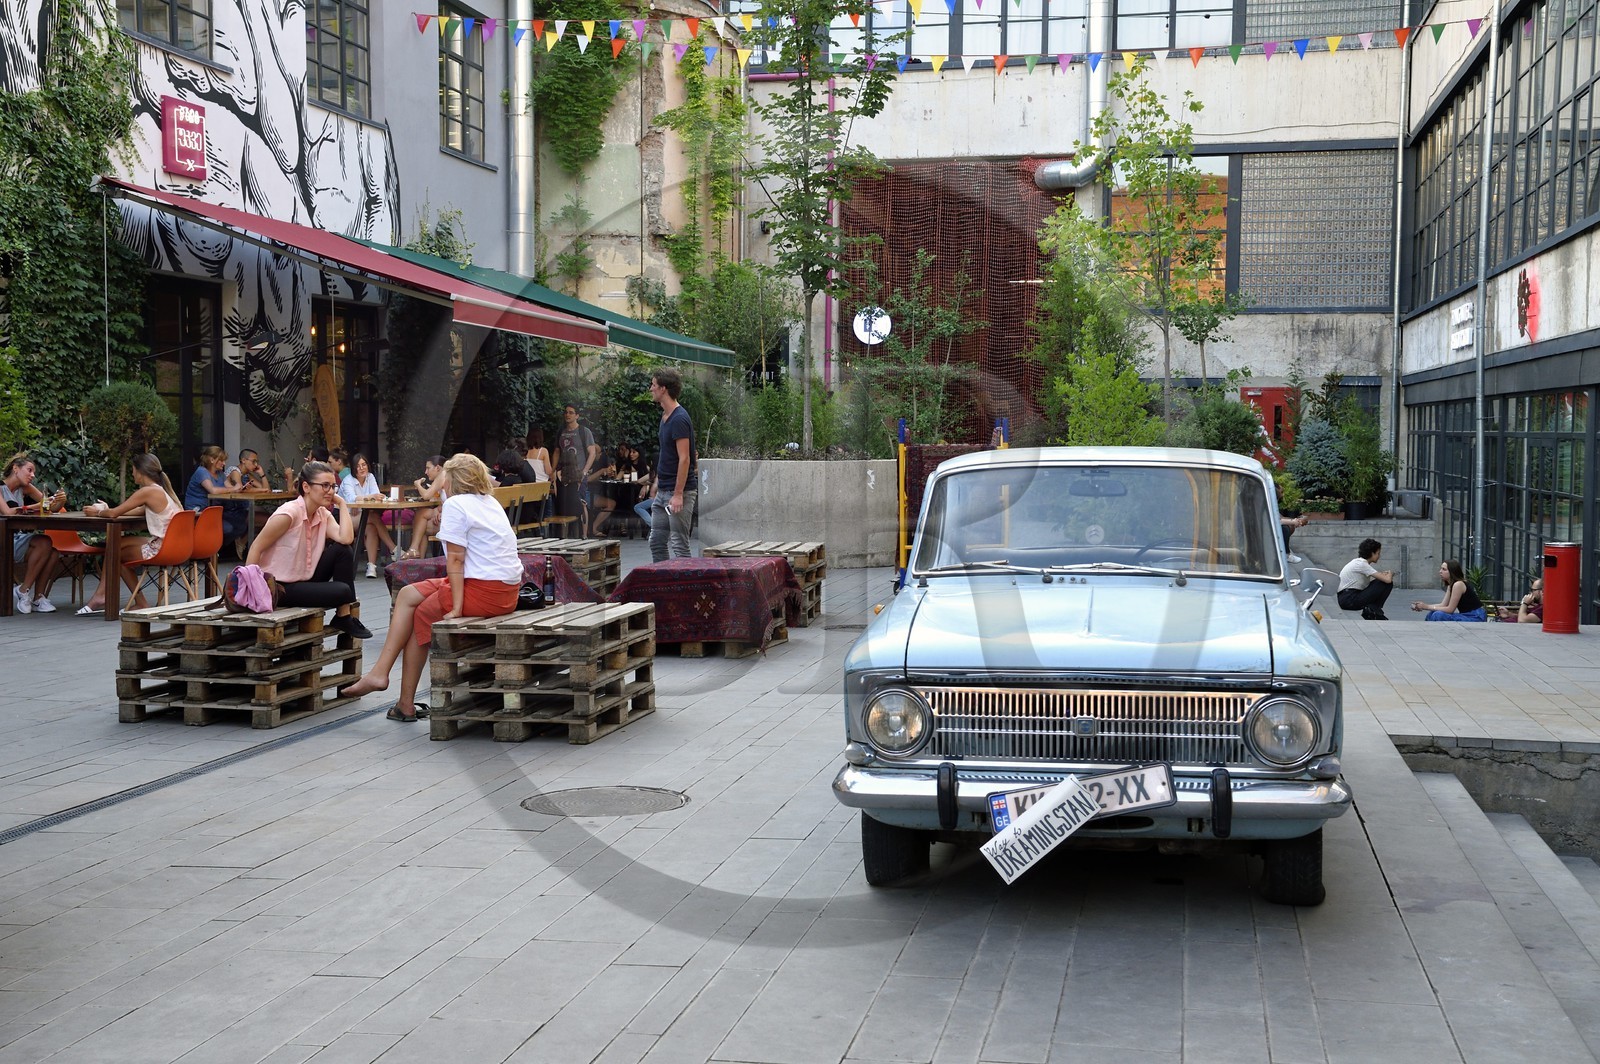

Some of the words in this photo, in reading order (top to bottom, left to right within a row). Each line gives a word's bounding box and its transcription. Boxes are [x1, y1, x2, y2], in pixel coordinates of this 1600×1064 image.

[994, 790, 1096, 878] DREAMINGSTAN
[995, 815, 1009, 827] GE
[984, 839, 1010, 857] Way
[1013, 827, 1022, 838] to
